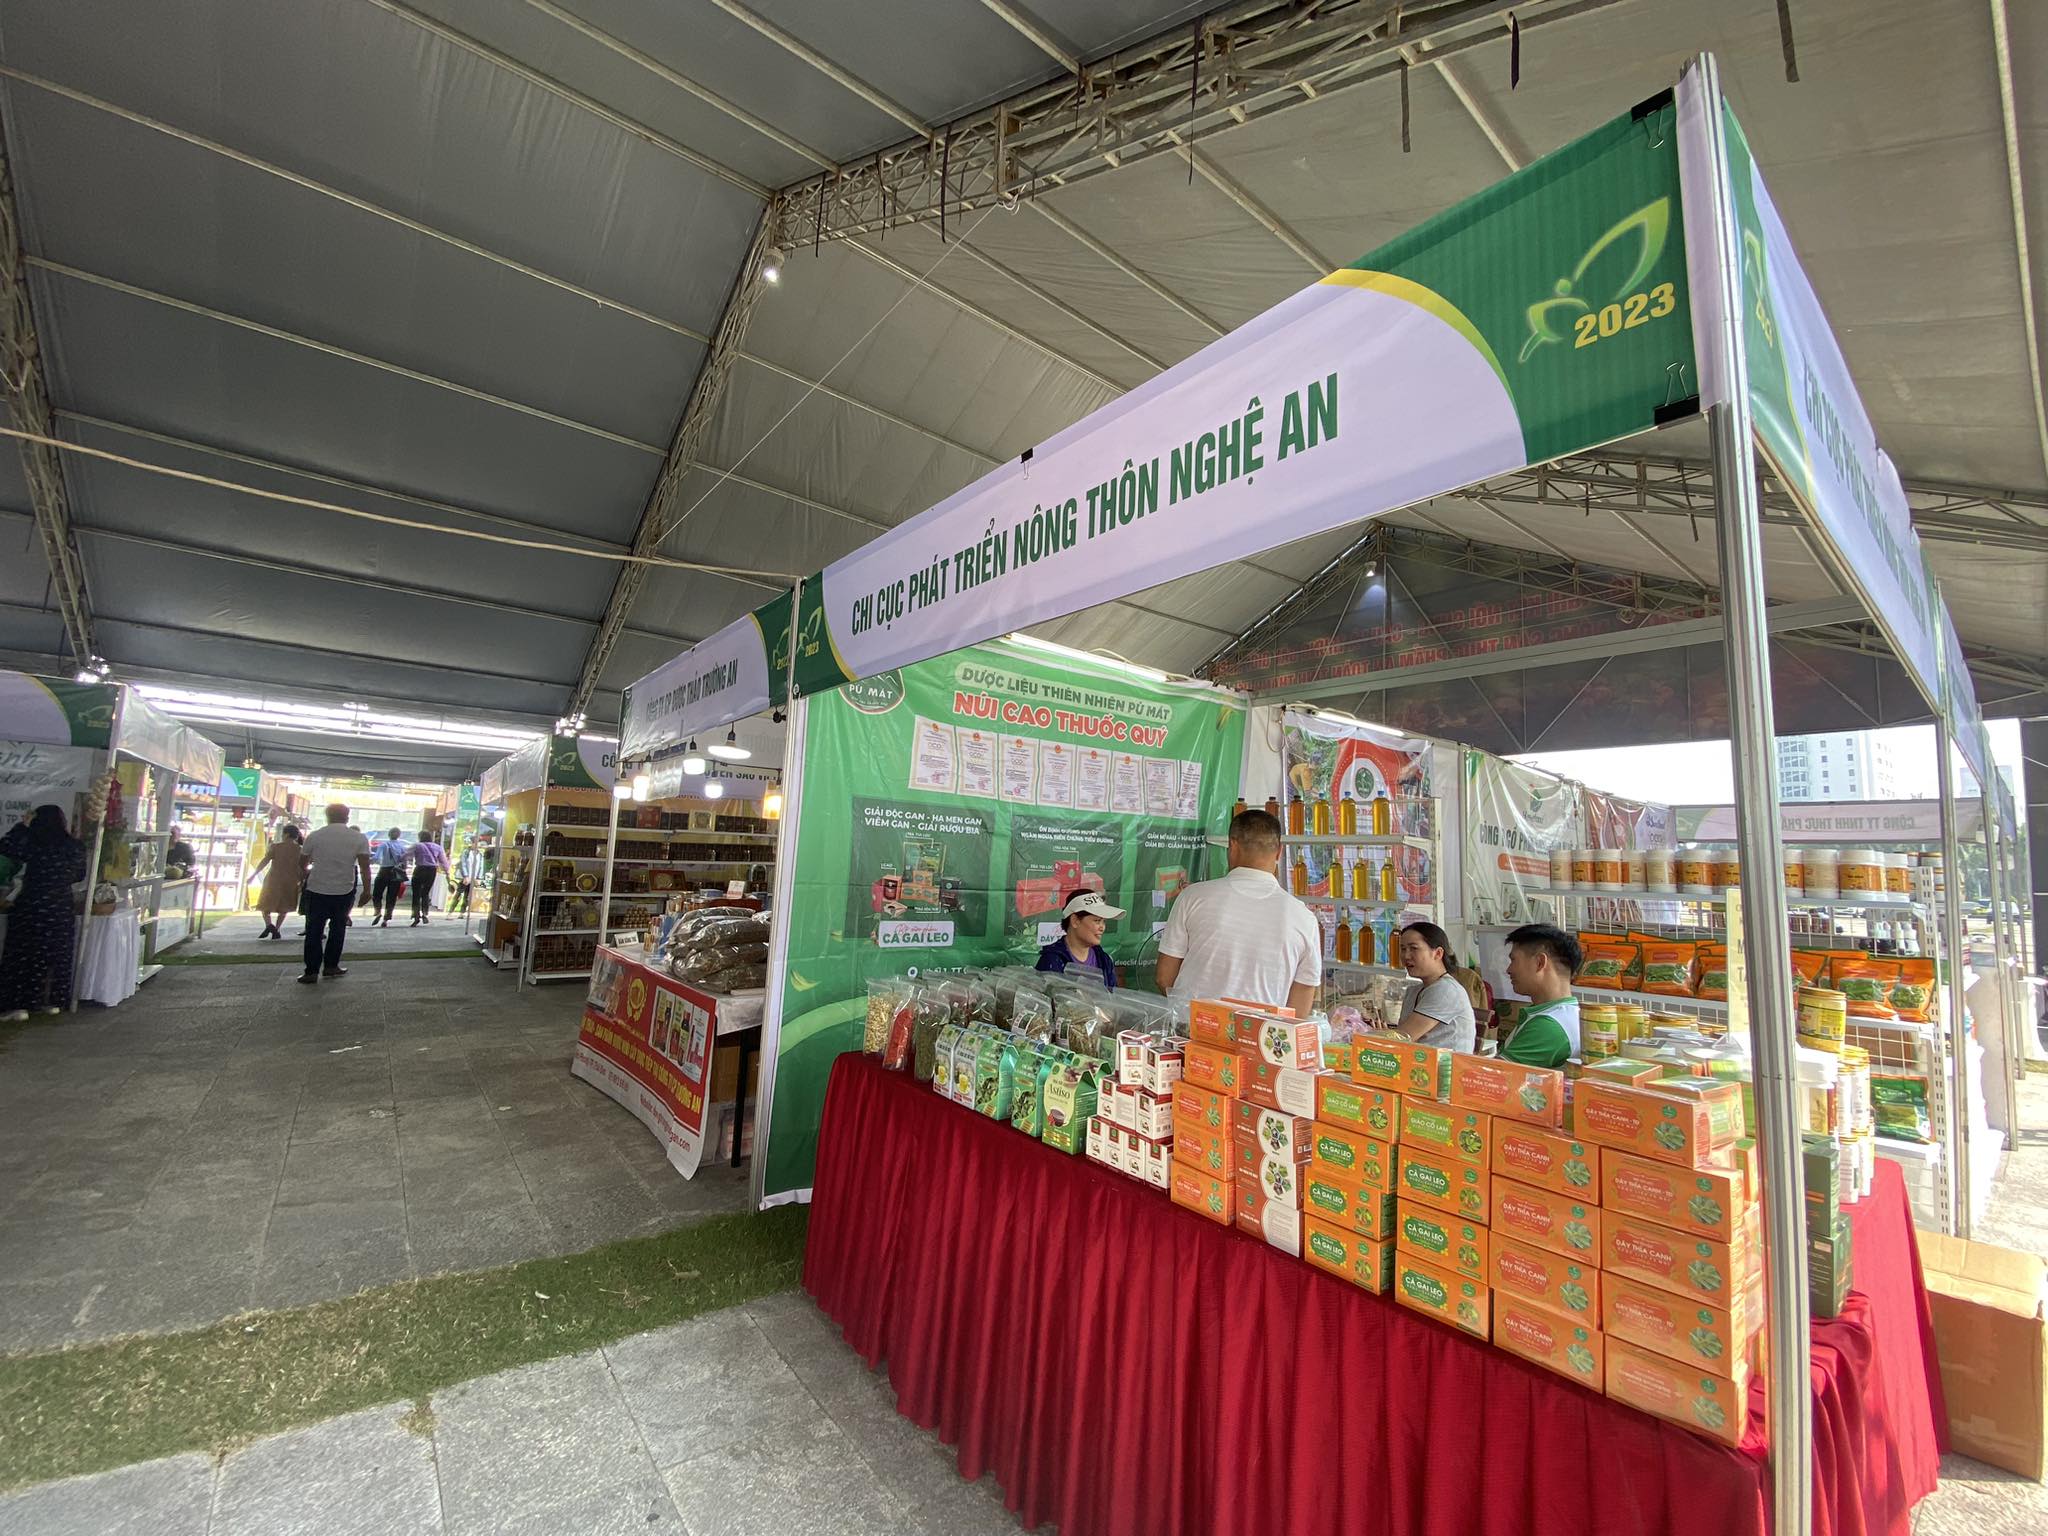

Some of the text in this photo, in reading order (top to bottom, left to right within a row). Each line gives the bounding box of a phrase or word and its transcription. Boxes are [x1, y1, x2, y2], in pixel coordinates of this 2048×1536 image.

[1574, 283, 1676, 349] 2023
[851, 371, 1338, 636] CHI CỤC PHÁT TRIỂN NÔNG THÔN NGHỆ AN
[805, 641, 819, 657] 2023
[777, 656, 788, 670] 202
[702, 662, 726, 698] TRƯỜNG
[727, 658, 738, 688] AN
[849, 683, 893, 699] PÙ MÁT
[961, 667, 1170, 720] DƯỢC LIỆU THIÊN NHIÊN PÙ MÁT
[953, 690, 1168, 748] NÚI CAO THUỐC QUÝ
[602, 752, 632, 769] CÔG
[864, 806, 884, 816] GIẢI
[885, 809, 903, 820] ĐỘC
[905, 812, 925, 820] GAN
[945, 816, 963, 824] MEN
[964, 817, 982, 825] GAN
[864, 817, 889, 827] VIÊM
[891, 819, 910, 829] GAN
[918, 820, 937, 831] GIẢI
[940, 823, 964, 834] RƯỢU
[965, 827, 980, 835] BIA
[1480, 821, 1498, 844] CÔNG
[1506, 827, 1517, 849] CỔ
[902, 932, 925, 943] GAI
[927, 932, 949, 942] LEO
[1041, 935, 1054, 943] DÂY
[1361, 1055, 1372, 1063] CÀ
[1372, 1057, 1384, 1065] GAI
[1426, 1119, 1436, 1129] CỔ
[1329, 1146, 1340, 1154] GAI
[1340, 1149, 1352, 1158] LEO
[1503, 1143, 1550, 1163] DÂY THÌA CANH
[1408, 1169, 1446, 1186] CÀ GAI LEO
[1312, 1187, 1343, 1204] CÀ GAI LEO
[1503, 1202, 1550, 1223] DÂY THÌA CANH
[1407, 1222, 1444, 1242] CÀ GAI LEO
[1312, 1237, 1343, 1256] CÀ GAI LEO
[1616, 1238, 1672, 1262] DÂY THÌA CANH
[1500, 1259, 1547, 1282] DÂY THÌA CANH
[1405, 1276, 1442, 1296] CÀ GAI LEO
[1505, 1317, 1553, 1343] DÂY THÌA CANH
